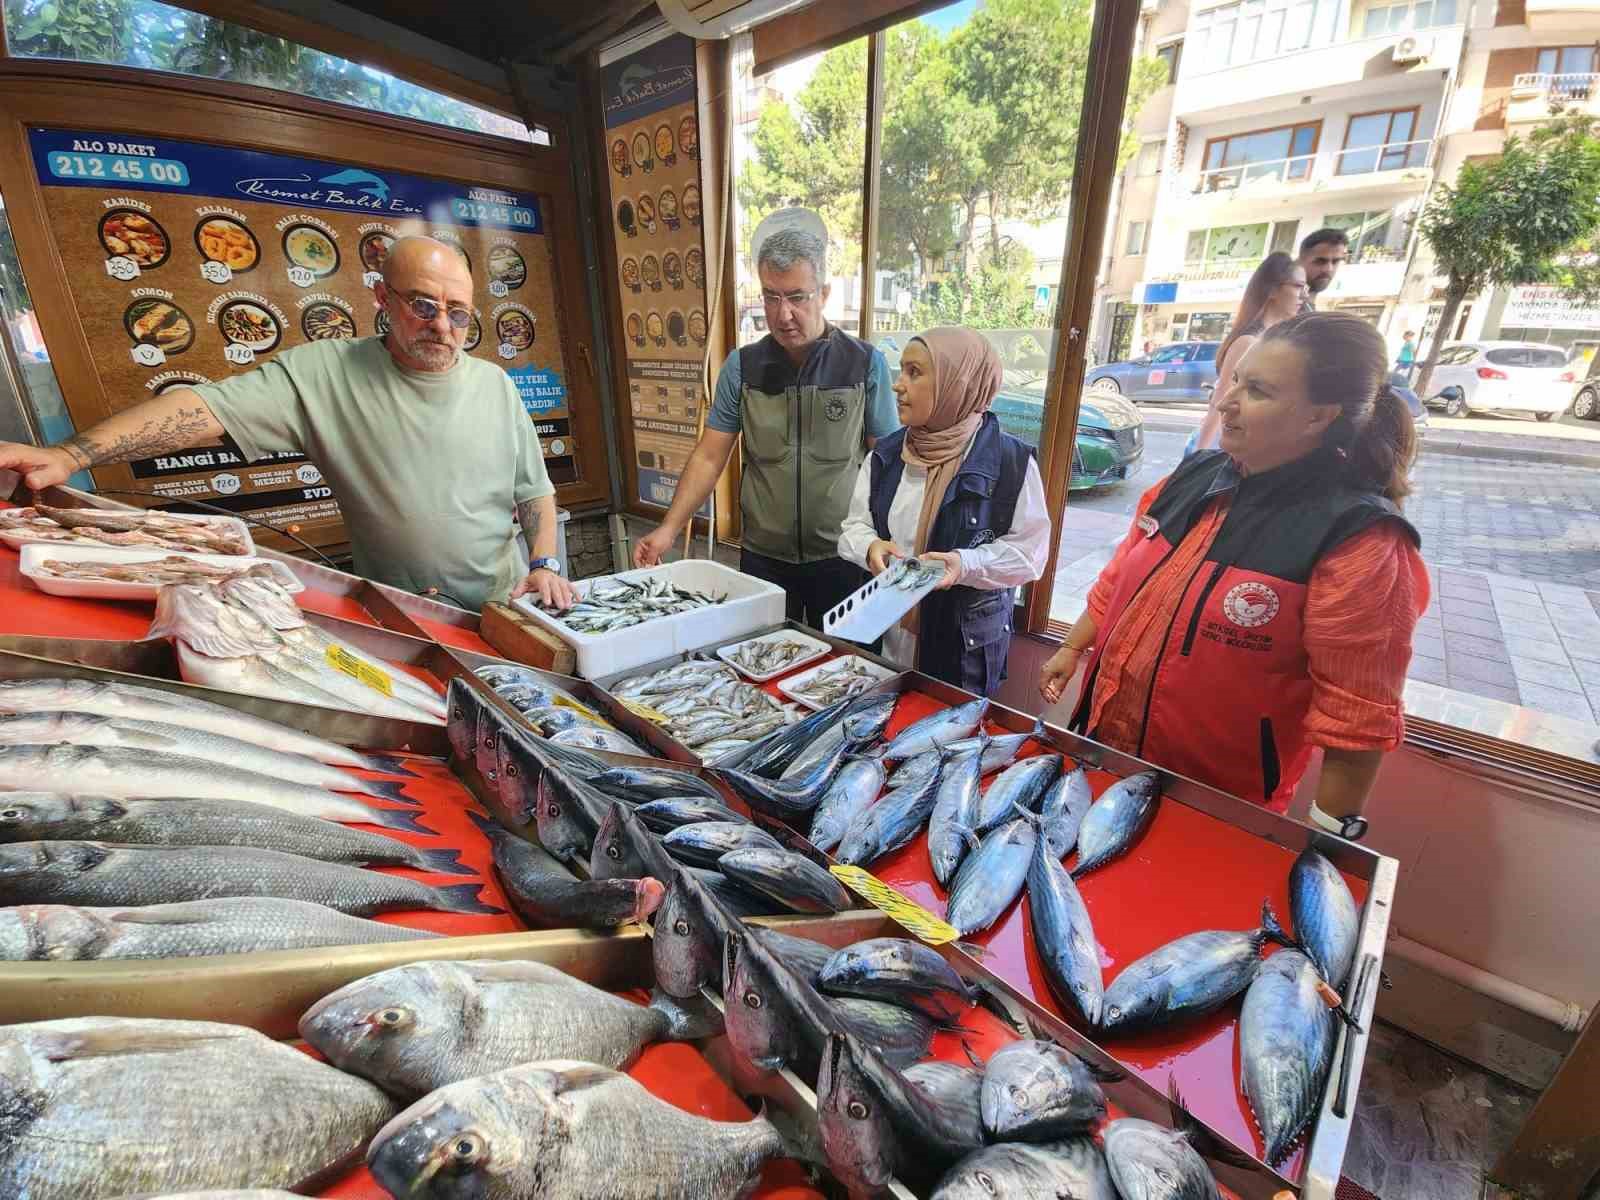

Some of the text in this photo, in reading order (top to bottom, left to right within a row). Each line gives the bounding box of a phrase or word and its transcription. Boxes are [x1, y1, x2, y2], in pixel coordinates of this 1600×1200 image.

[73, 140, 156, 156] ALO PAKET
[56, 156, 181, 182] 212 45 00
[458, 203, 488, 220] 212
[513, 210, 532, 225] 00
[154, 451, 216, 470] HANGİ
